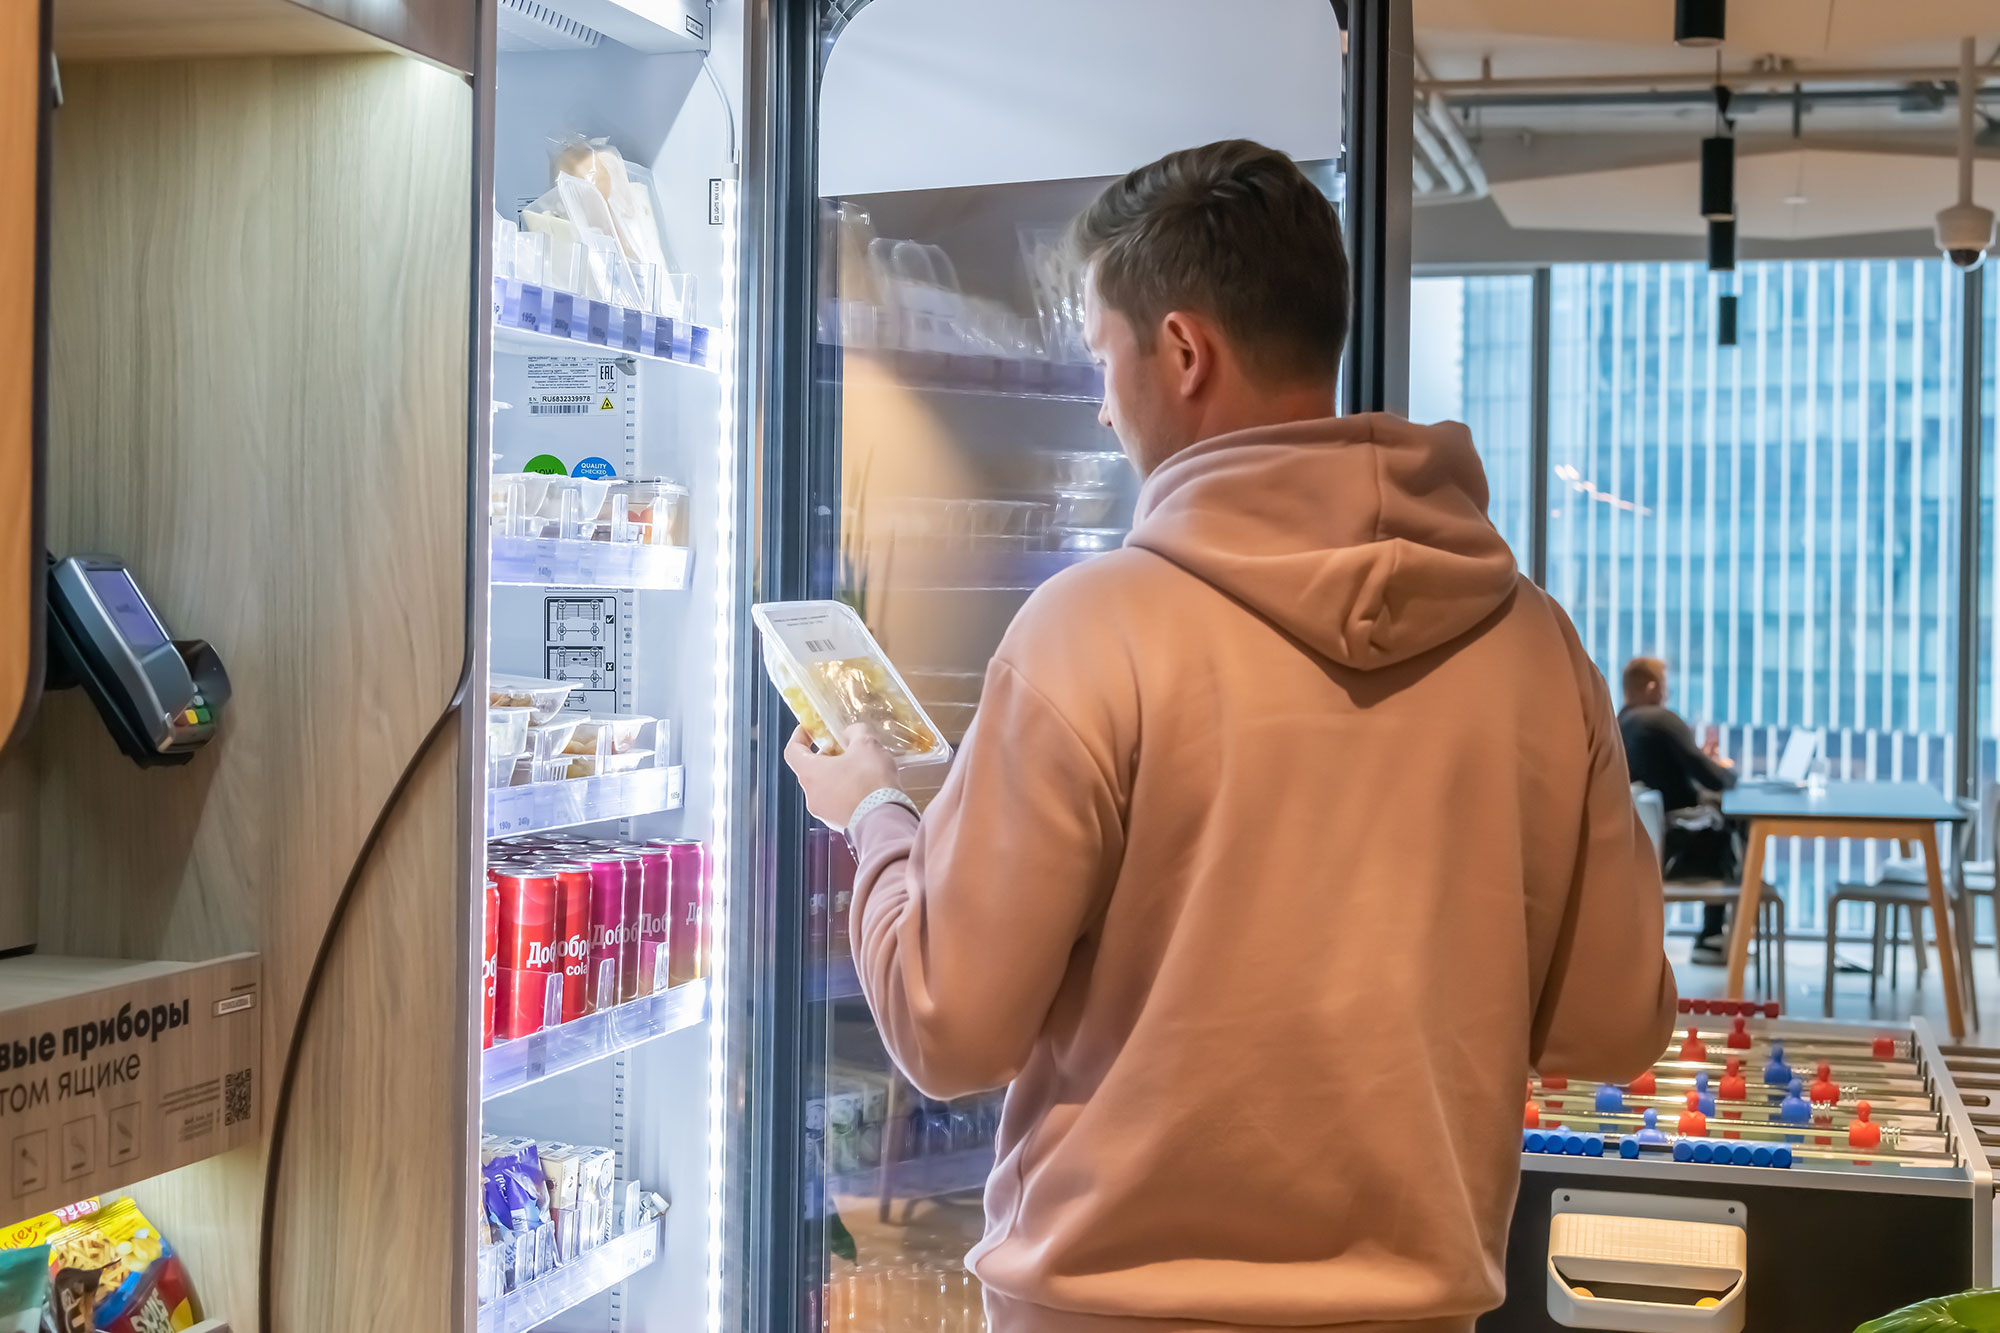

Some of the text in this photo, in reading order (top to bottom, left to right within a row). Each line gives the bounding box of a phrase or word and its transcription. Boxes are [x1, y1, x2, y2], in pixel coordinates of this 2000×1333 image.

[600, 366, 614, 380] EAC
[0, 998, 190, 1072] вые приборы
[58, 1053, 141, 1101] ящике
